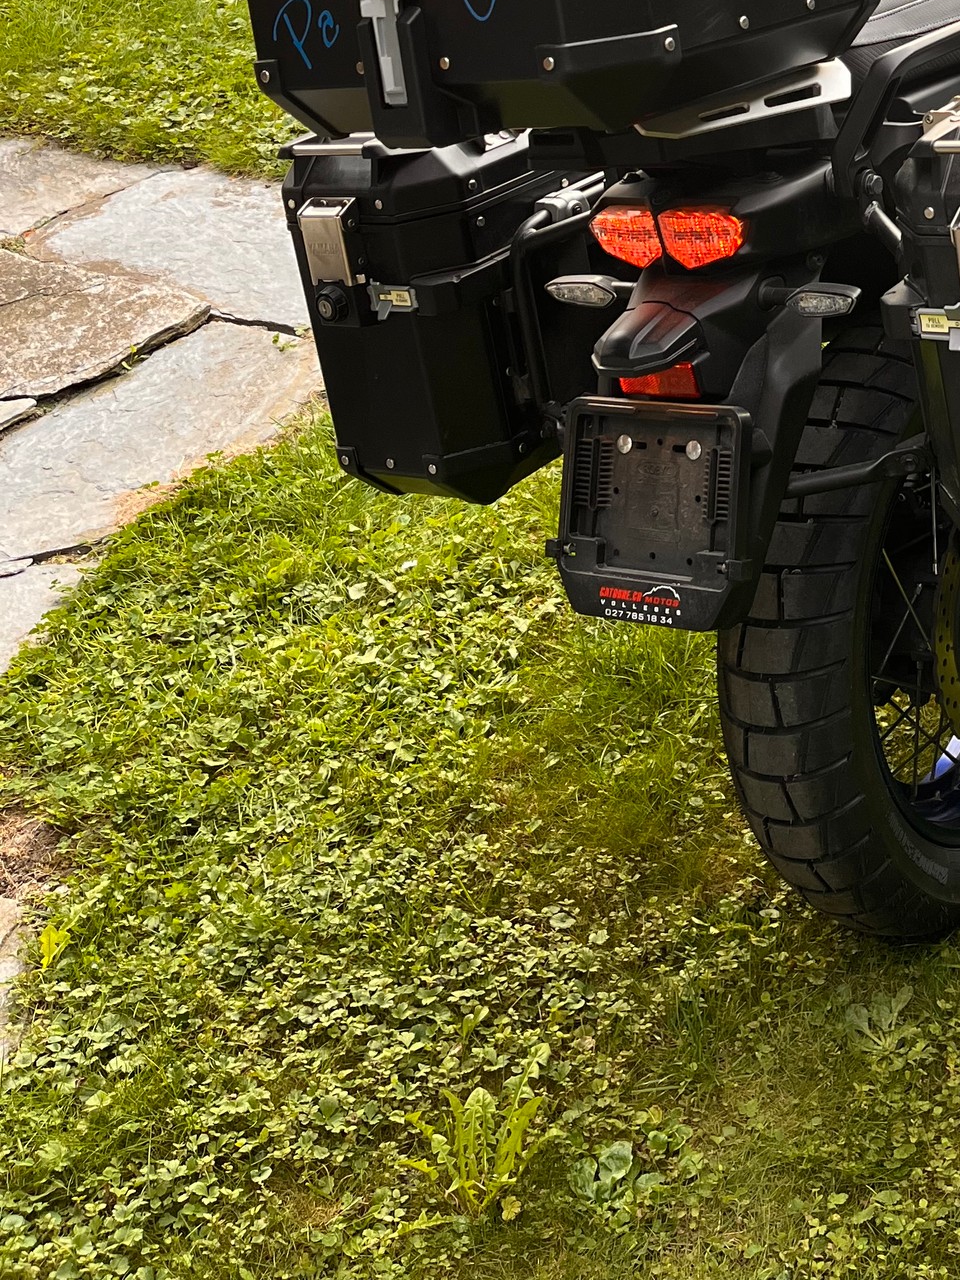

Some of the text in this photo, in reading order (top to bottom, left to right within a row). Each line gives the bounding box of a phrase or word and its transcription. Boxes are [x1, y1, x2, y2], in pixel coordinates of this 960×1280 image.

[604, 608, 673, 625] 027 785 18 34
